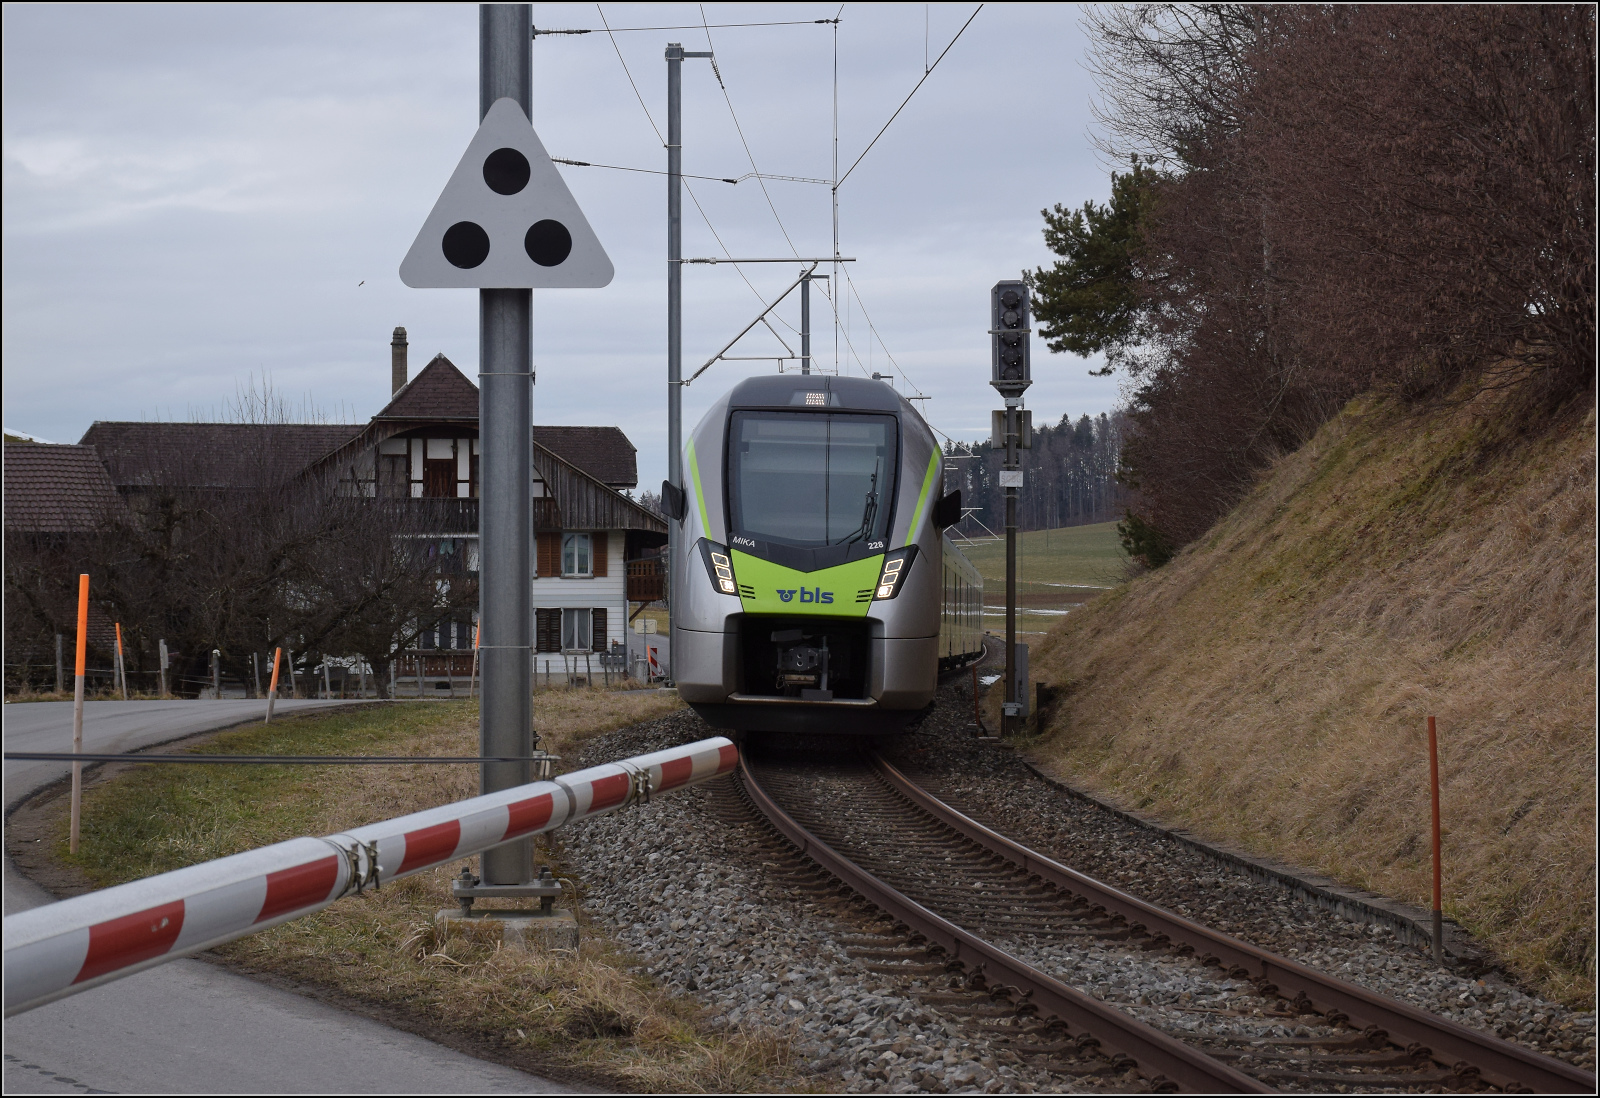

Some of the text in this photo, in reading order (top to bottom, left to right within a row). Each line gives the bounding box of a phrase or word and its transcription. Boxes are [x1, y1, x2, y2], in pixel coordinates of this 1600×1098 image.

[732, 536, 755, 548] MIKA
[867, 540, 884, 550] 228
[799, 586, 834, 603] bls
